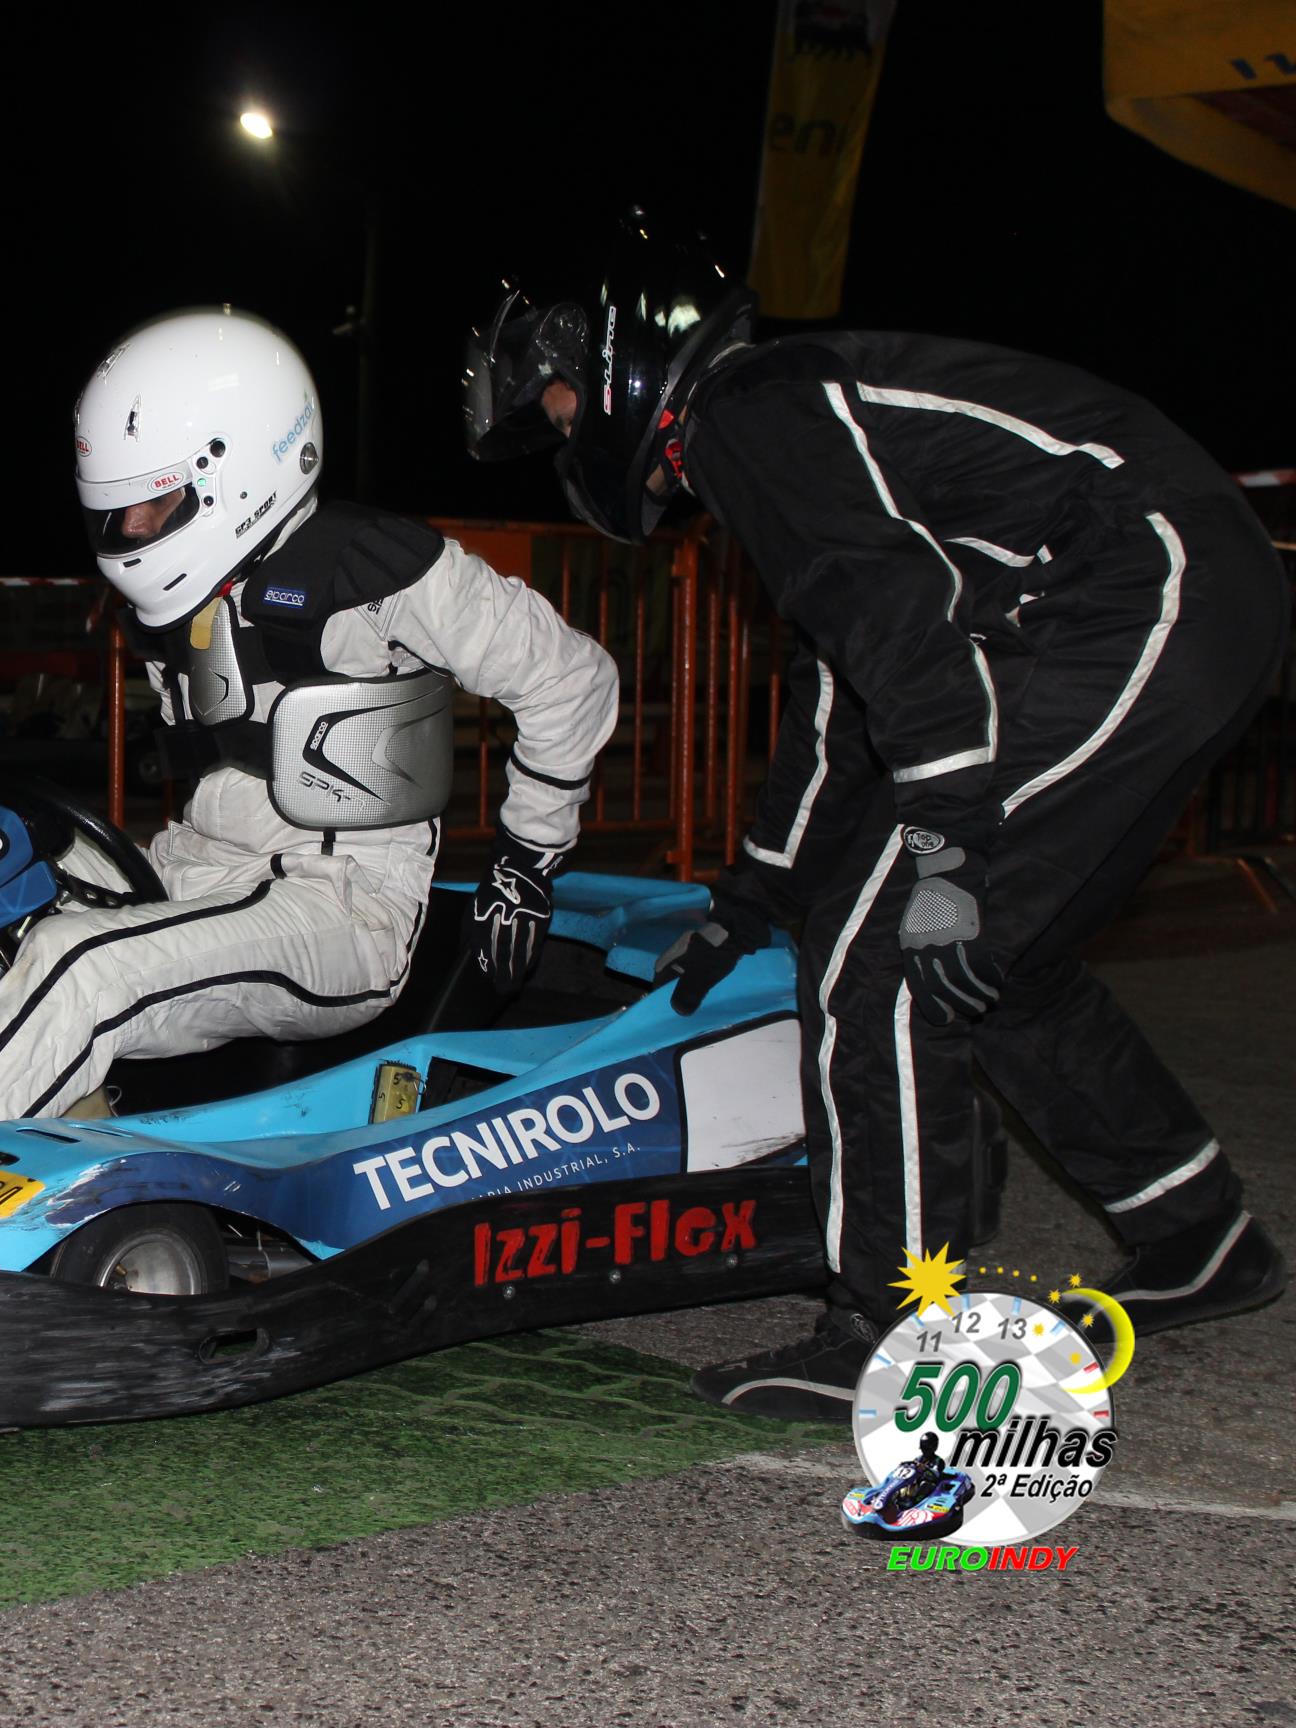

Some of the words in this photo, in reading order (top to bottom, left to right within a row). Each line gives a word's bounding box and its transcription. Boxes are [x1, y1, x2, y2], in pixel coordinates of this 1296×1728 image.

[154, 475, 180, 488] BELL
[254, 491, 277, 518] SPORT
[265, 589, 305, 604] sparco
[352, 1072, 661, 1211] TECNIROLO
[517, 1153, 608, 1192] INDUSTRIAL,
[612, 1143, 641, 1159] S.A.
